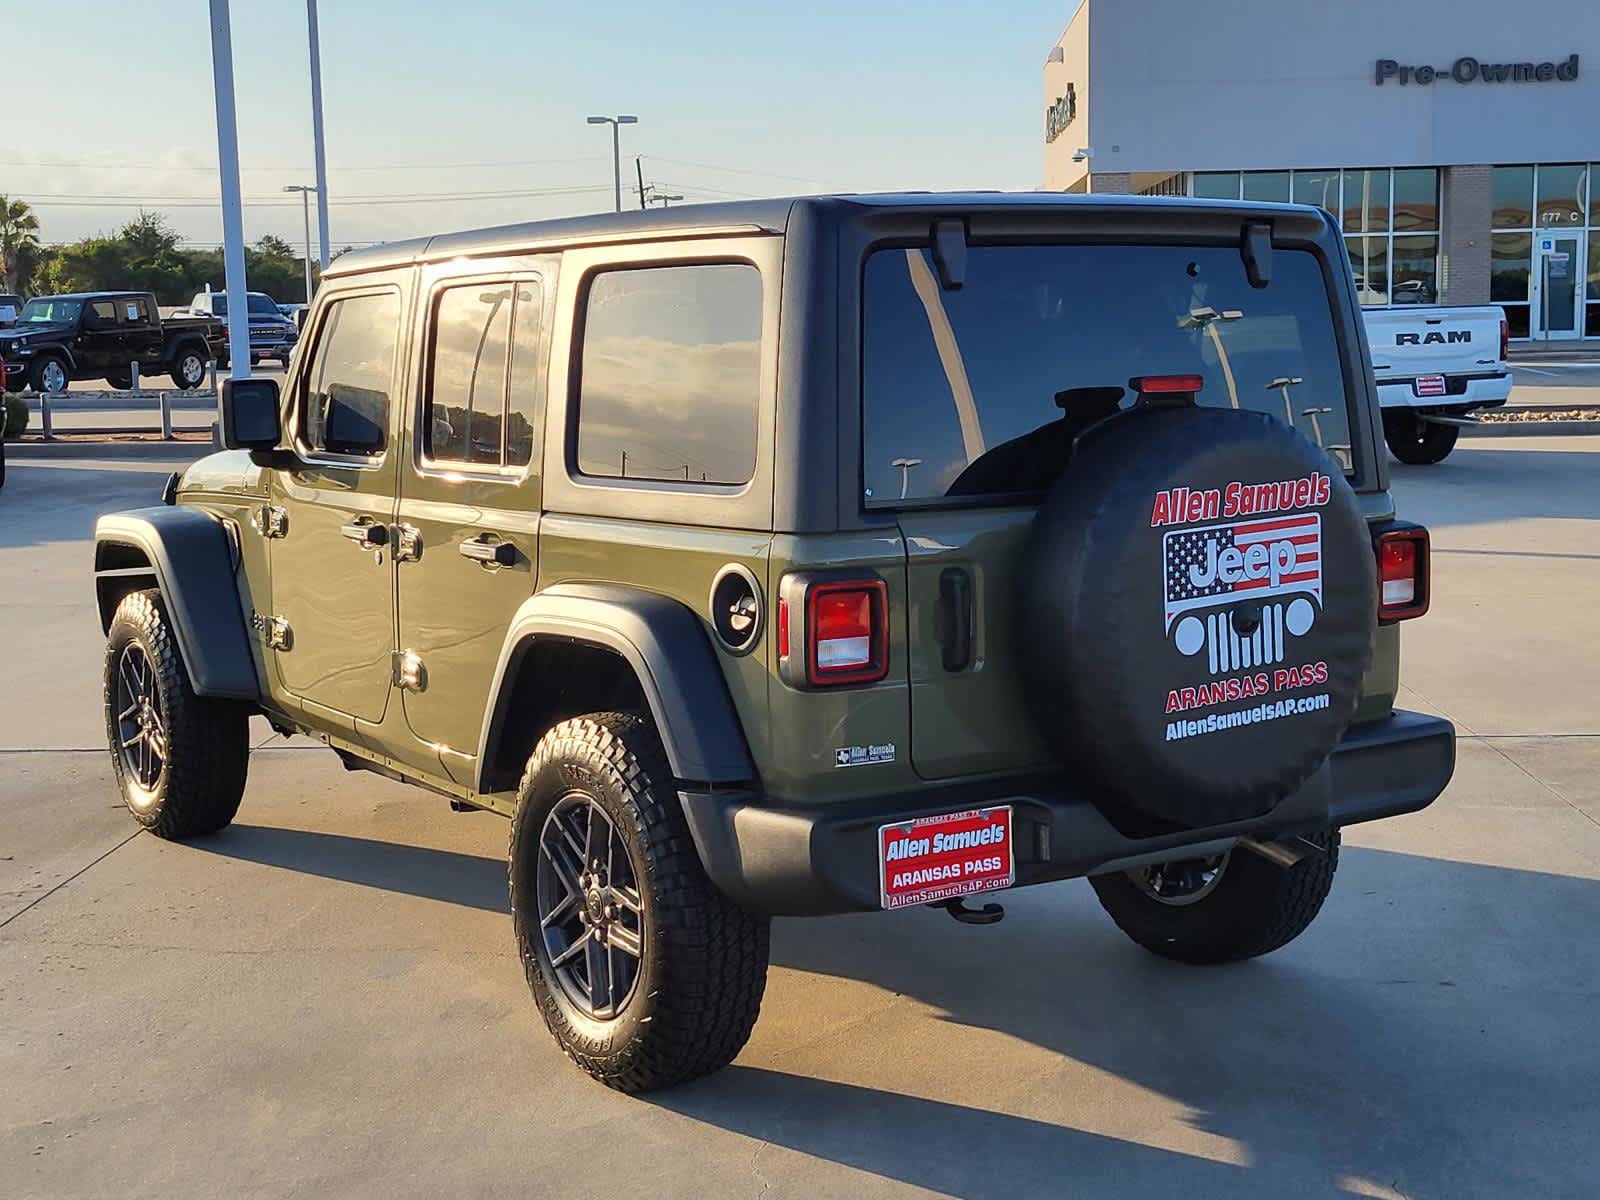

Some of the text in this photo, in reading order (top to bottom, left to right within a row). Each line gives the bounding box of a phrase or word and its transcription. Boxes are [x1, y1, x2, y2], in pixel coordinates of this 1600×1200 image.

[1375, 54, 1579, 86] Pre-Owned
[1396, 331, 1472, 346] RAM
[1151, 472, 1331, 527] Allen Samuels
[1189, 538, 1297, 589] Jeep
[1165, 661, 1329, 713] ARANSAS PASS
[1165, 693, 1330, 741] AllenSamuelsAP.com
[886, 823, 1005, 862] Allen Samuels
[892, 856, 1002, 889] ARANSAS PASS
[889, 877, 1010, 908] AllenSamuelsAP.com
